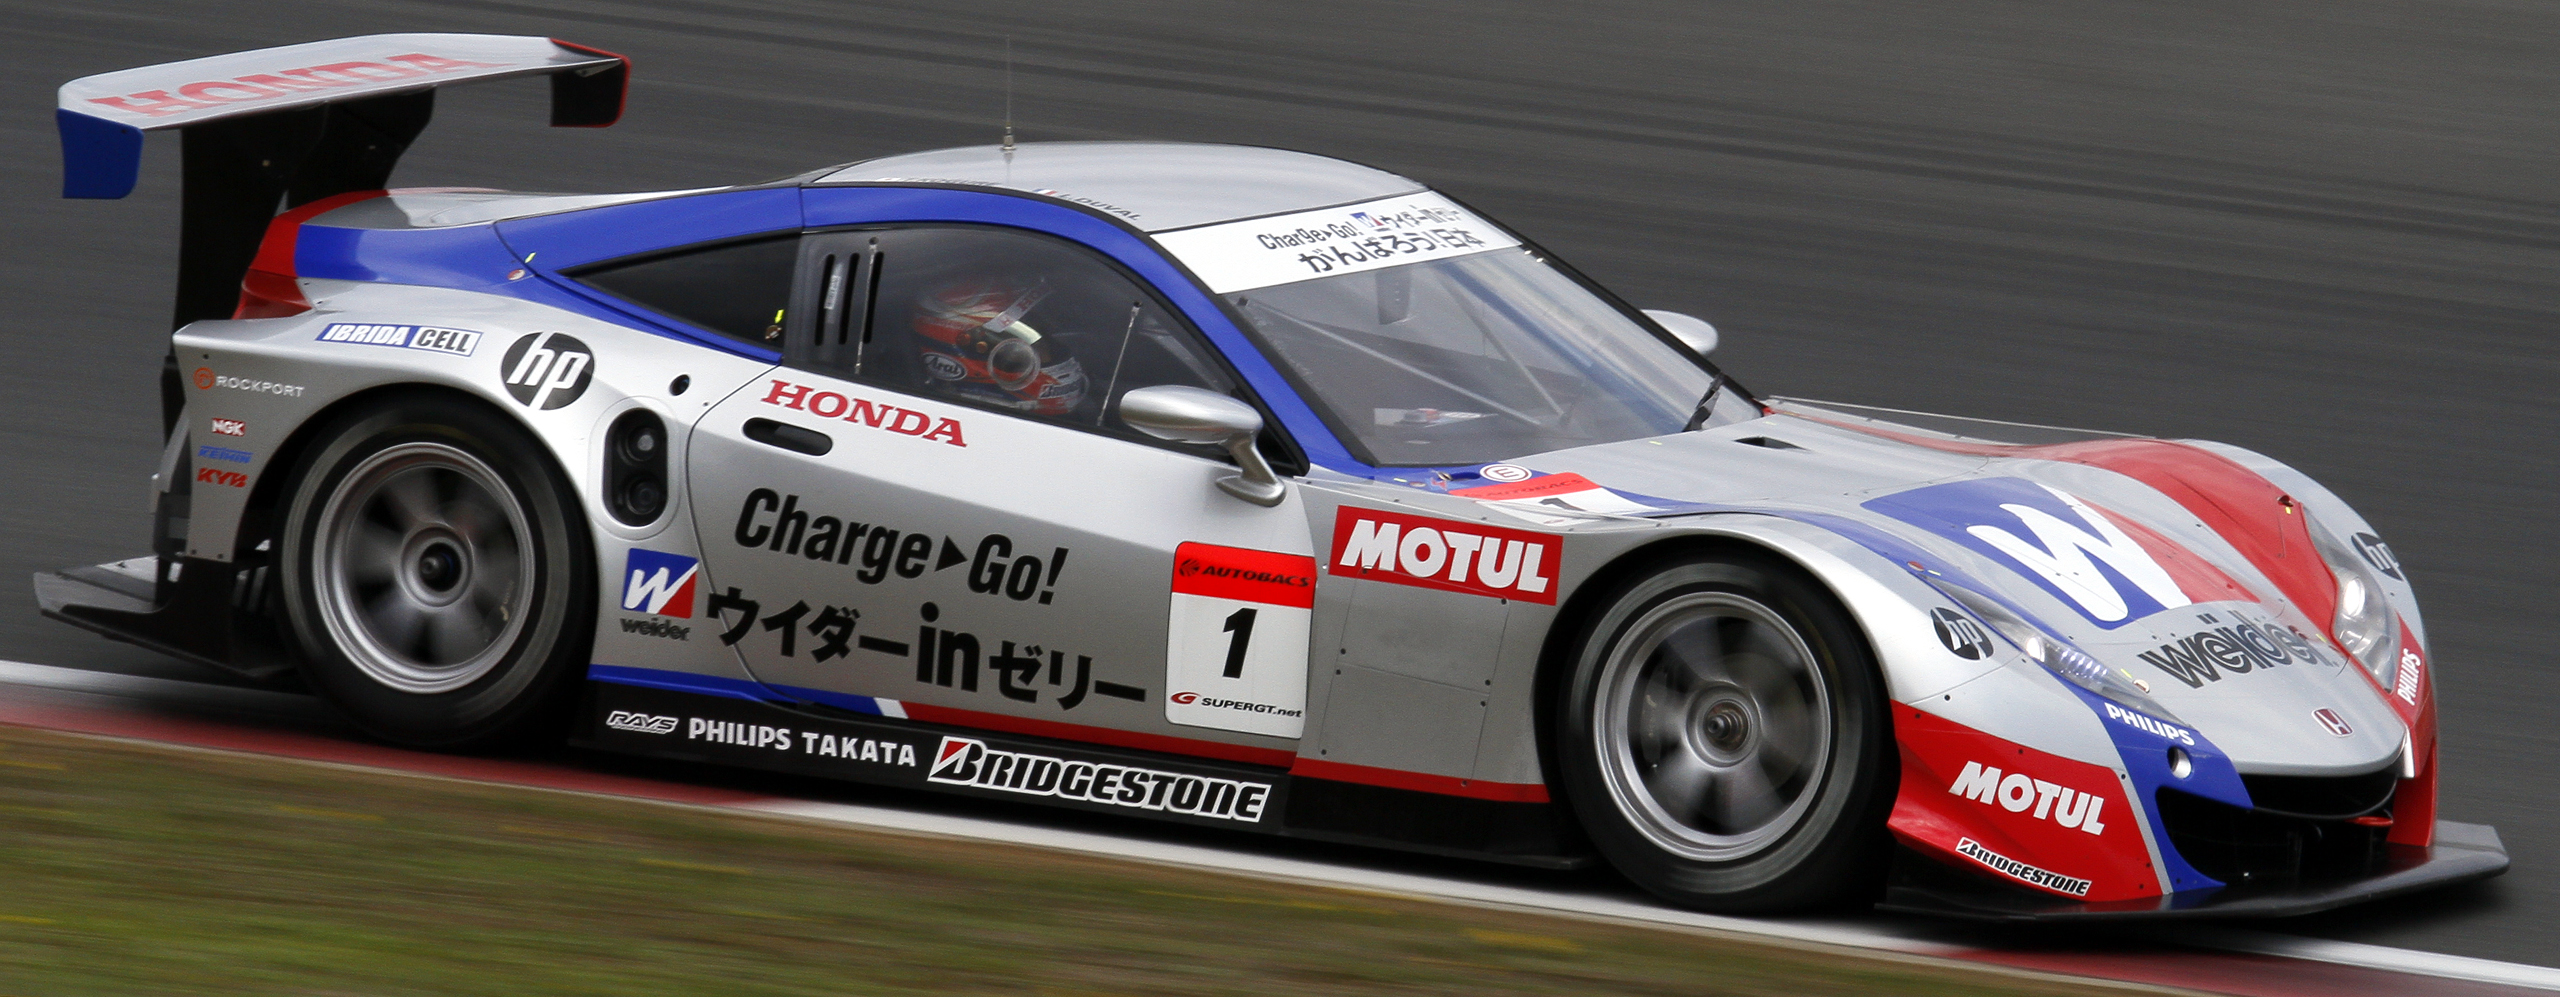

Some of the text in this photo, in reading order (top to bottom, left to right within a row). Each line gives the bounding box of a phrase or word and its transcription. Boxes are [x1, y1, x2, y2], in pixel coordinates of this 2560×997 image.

[88, 53, 517, 117] HONDA
[1257, 221, 1364, 249] Charge Go!
[322, 324, 474, 352] IBRIDA CELL
[216, 375, 305, 398] ROCKPORT
[505, 332, 592, 410] hp
[211, 419, 245, 436] NGK
[761, 380, 968, 448] HONDA
[197, 467, 248, 488] KYB
[735, 487, 1069, 604] Charge Go!
[1340, 518, 1549, 593] MOTUL
[1201, 566, 1312, 588] AUTOBACS
[620, 617, 691, 641] weider
[706, 586, 1146, 711] ウイダーinゼリー
[1222, 607, 1258, 679] 1
[1931, 607, 1987, 660] hp
[2397, 648, 2421, 706] PHILIPS
[606, 710, 679, 733] RAYS
[1201, 697, 1303, 718] SUPERGT.net
[2104, 702, 2195, 746] PHILIPS
[688, 717, 917, 767] PHILIPS TAKATA
[927, 735, 1272, 823] BRIDGESTONE
[1949, 761, 2105, 835] MOTUL
[1956, 836, 2093, 896] BRIDGESTONE
